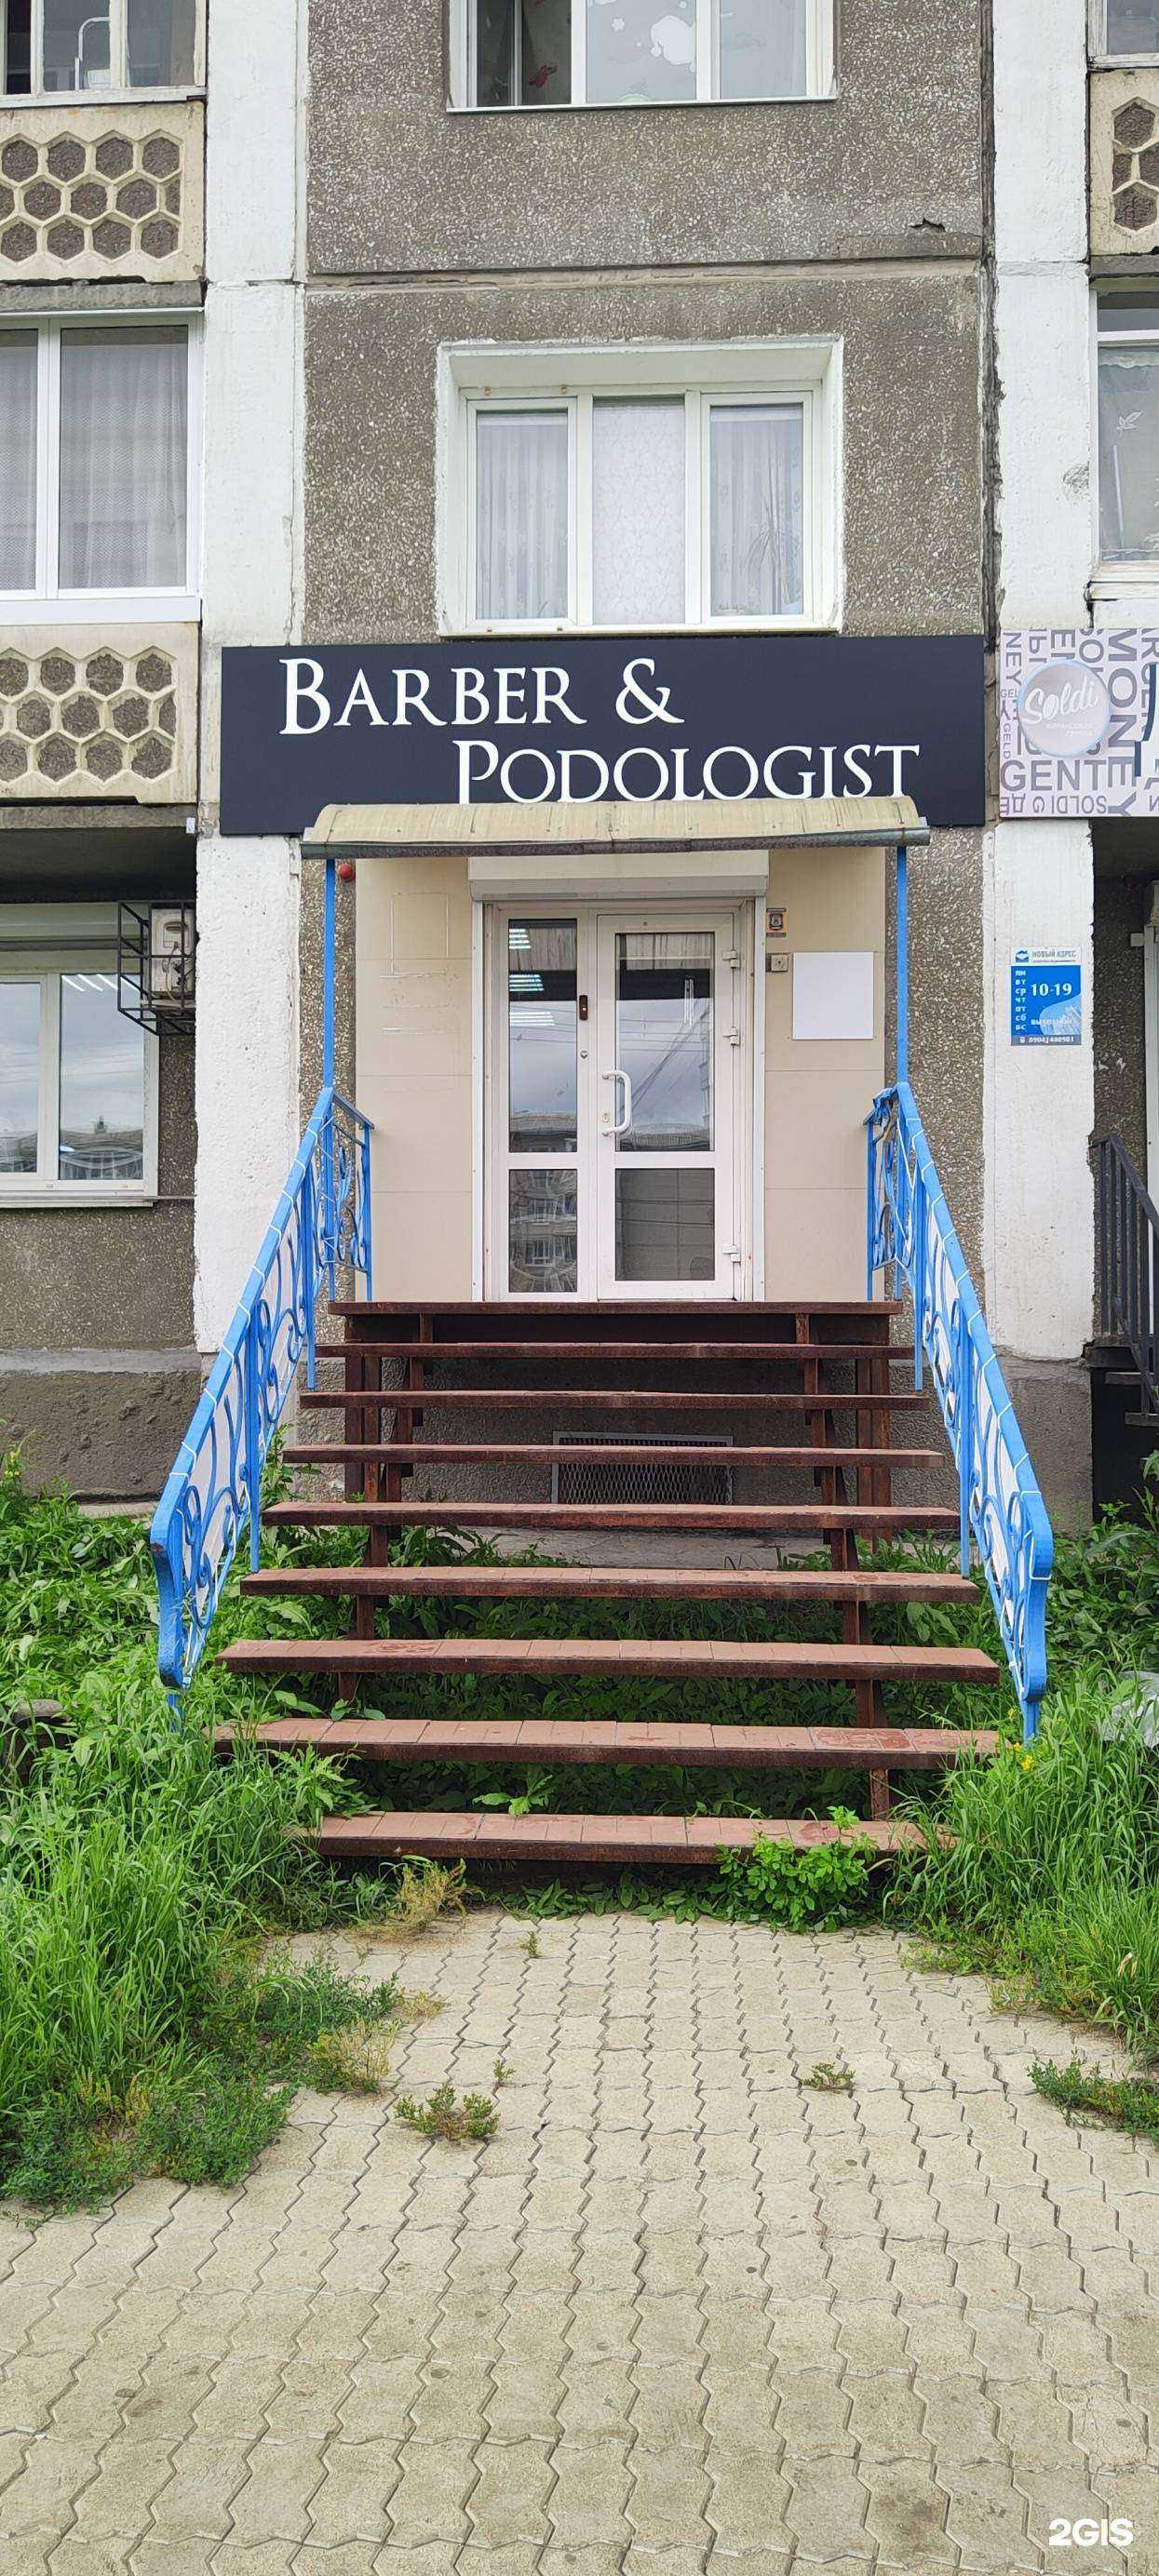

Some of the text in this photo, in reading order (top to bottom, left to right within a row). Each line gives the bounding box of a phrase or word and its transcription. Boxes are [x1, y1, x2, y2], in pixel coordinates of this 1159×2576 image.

[278, 657, 685, 735] BARBER &
[1023, 676, 1099, 724] Soldi
[452, 740, 920, 804] PODOLOGIST
[1031, 983, 1072, 997] 10-19
